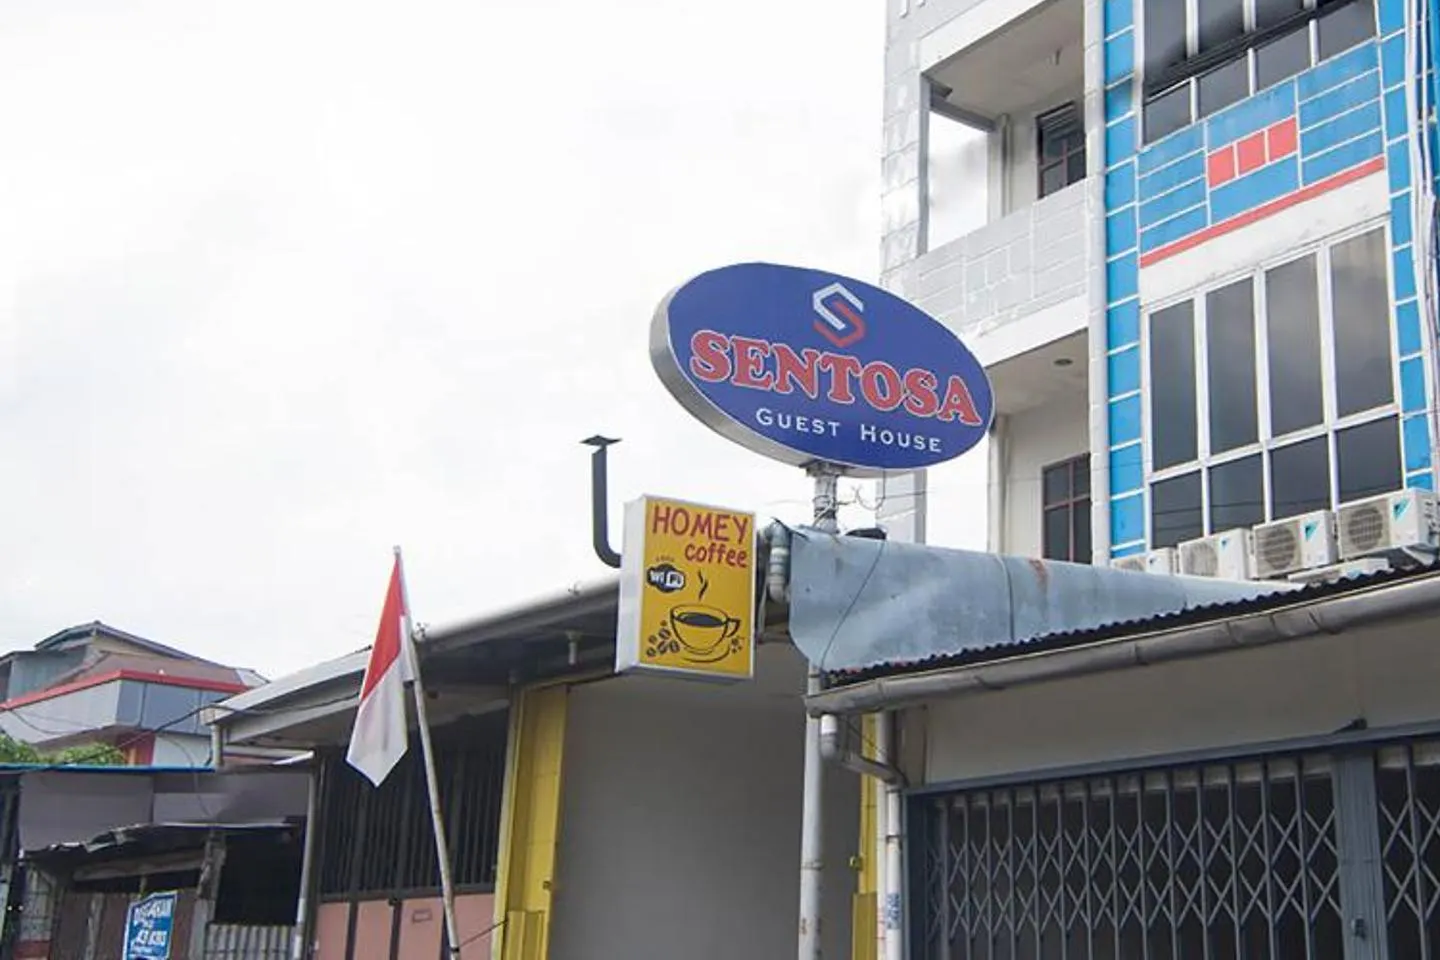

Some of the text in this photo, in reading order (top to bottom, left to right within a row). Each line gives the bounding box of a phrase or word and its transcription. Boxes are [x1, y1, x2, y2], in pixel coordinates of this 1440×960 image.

[690, 330, 983, 426] SENTOSA
[755, 407, 942, 452] GUEST HOUSE
[652, 505, 748, 543] HOMEY
[684, 543, 748, 568] coffee
